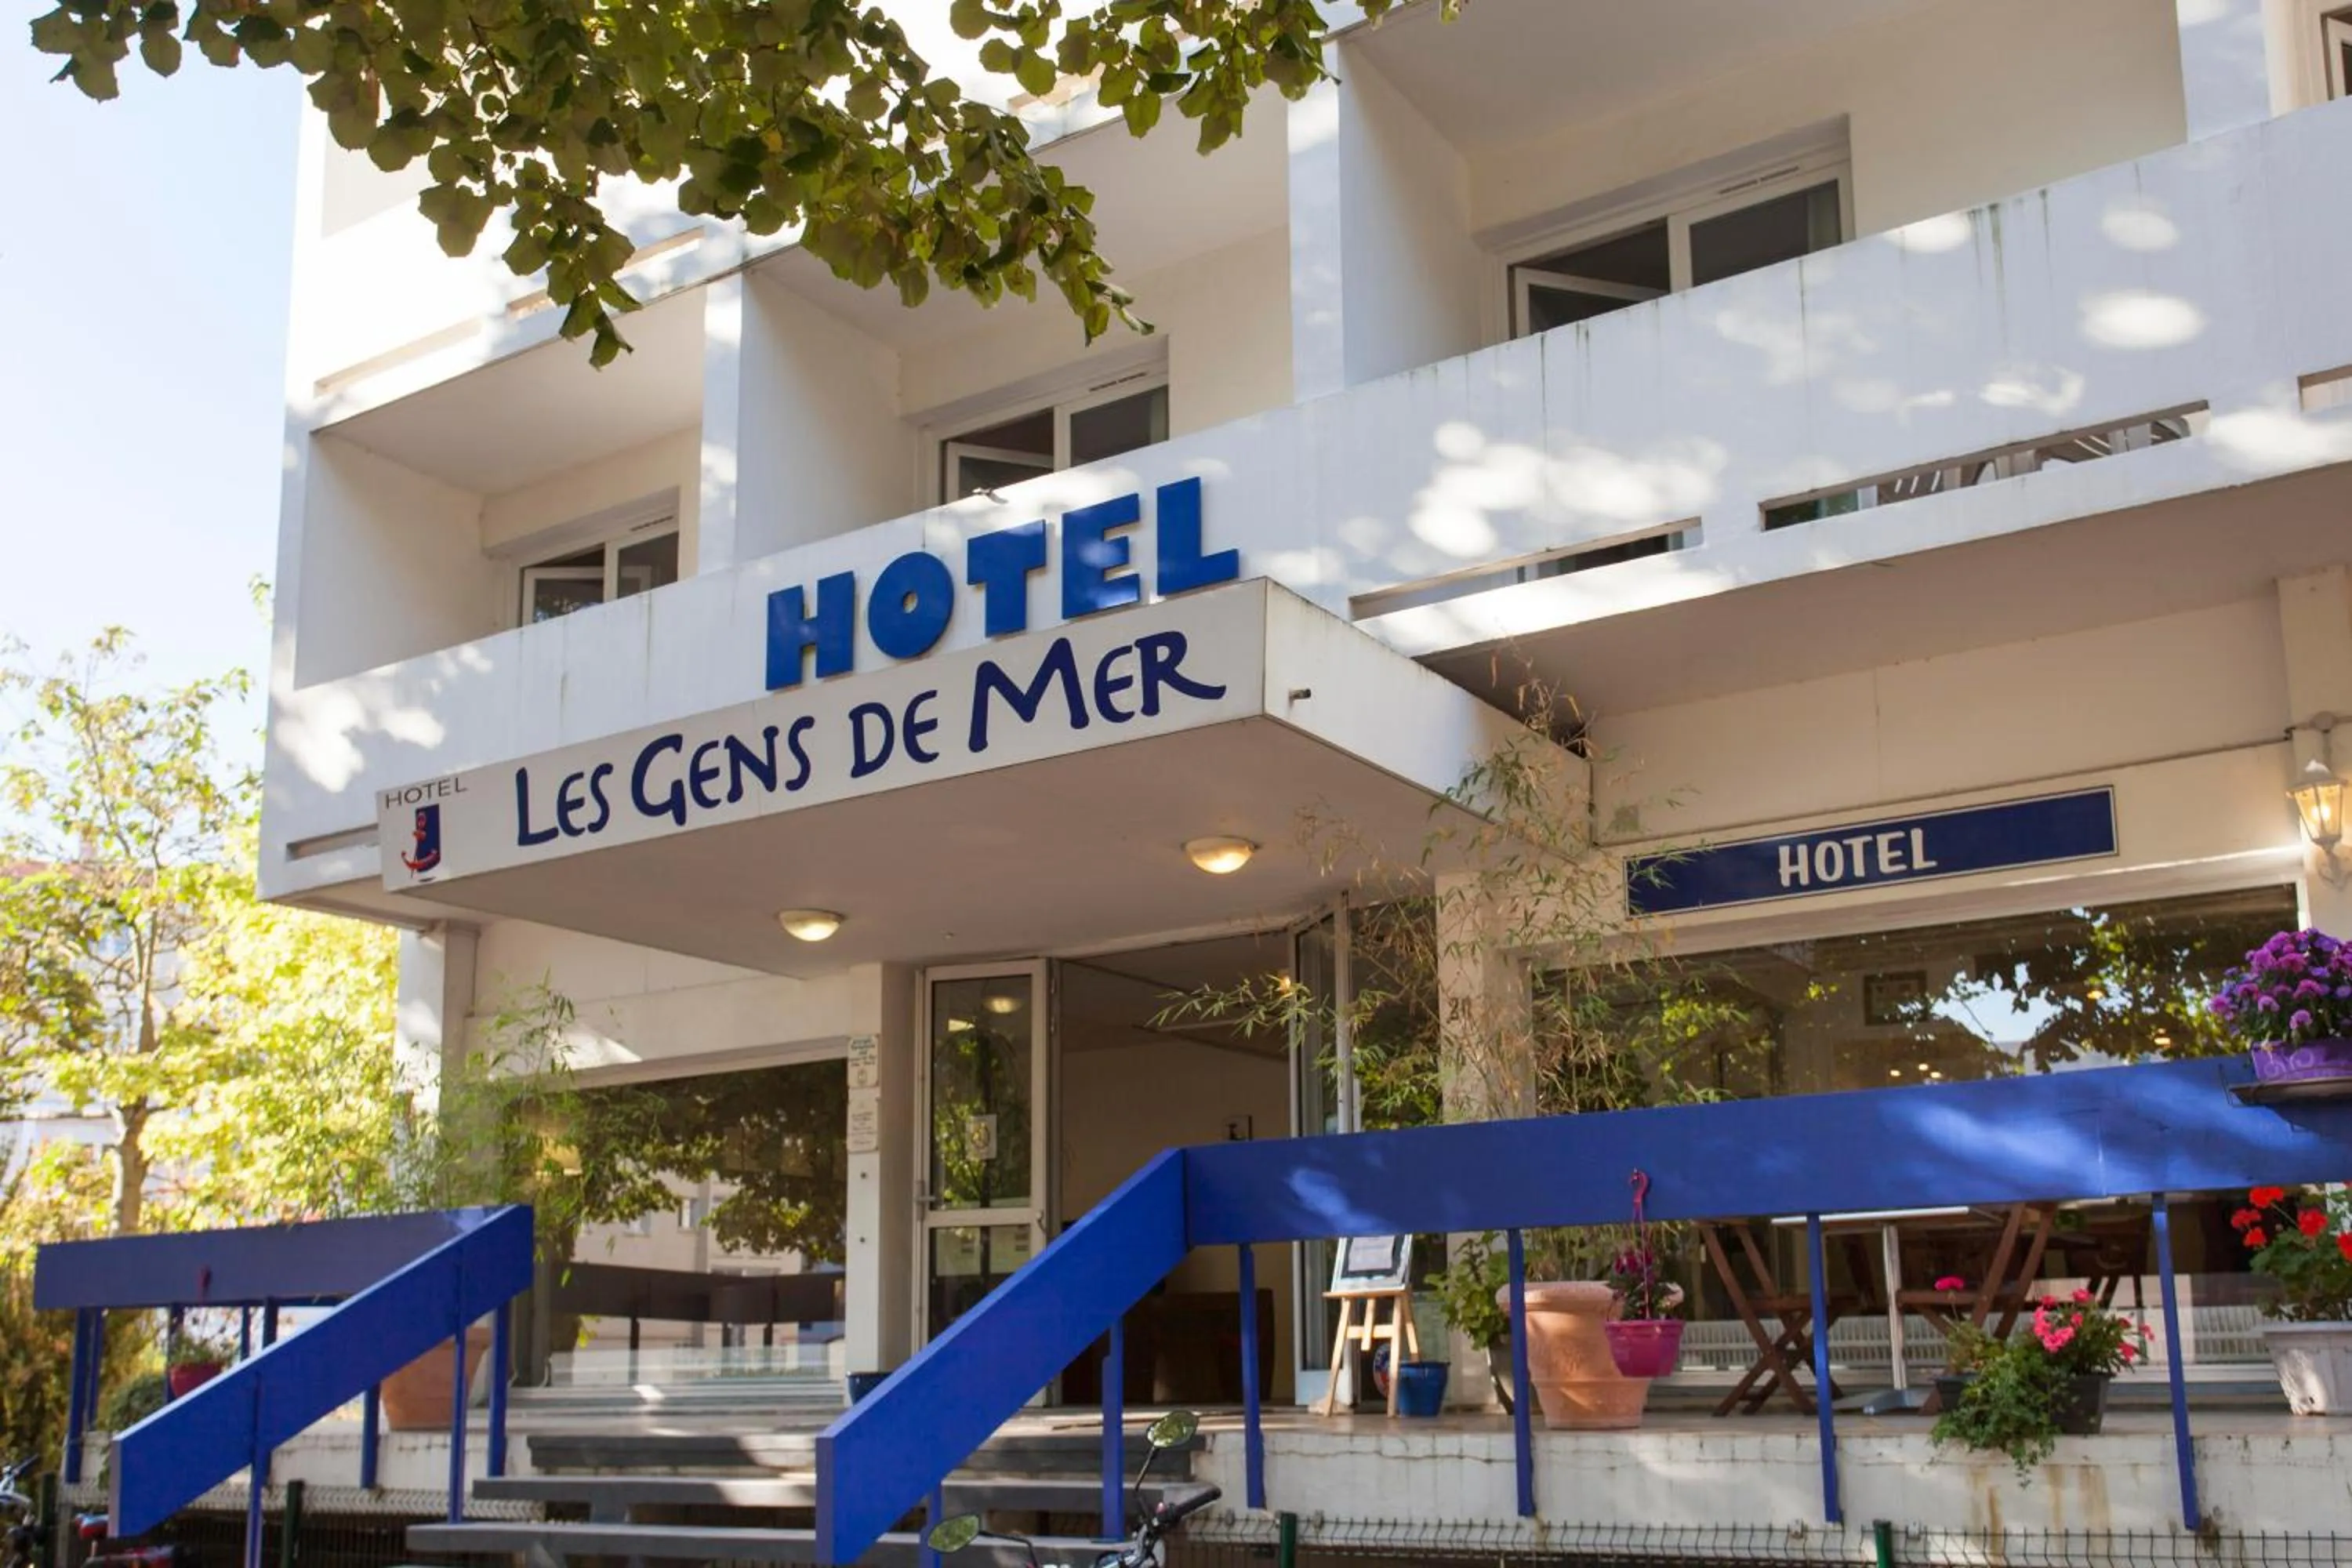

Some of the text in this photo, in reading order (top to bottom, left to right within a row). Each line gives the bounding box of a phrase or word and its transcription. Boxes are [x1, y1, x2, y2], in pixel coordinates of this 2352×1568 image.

[764, 475, 1240, 691] HOTEL
[385, 777, 468, 809] HOTEL
[515, 630, 1226, 846] LES GENS DE MER
[1778, 827, 1937, 887] HOTEL
